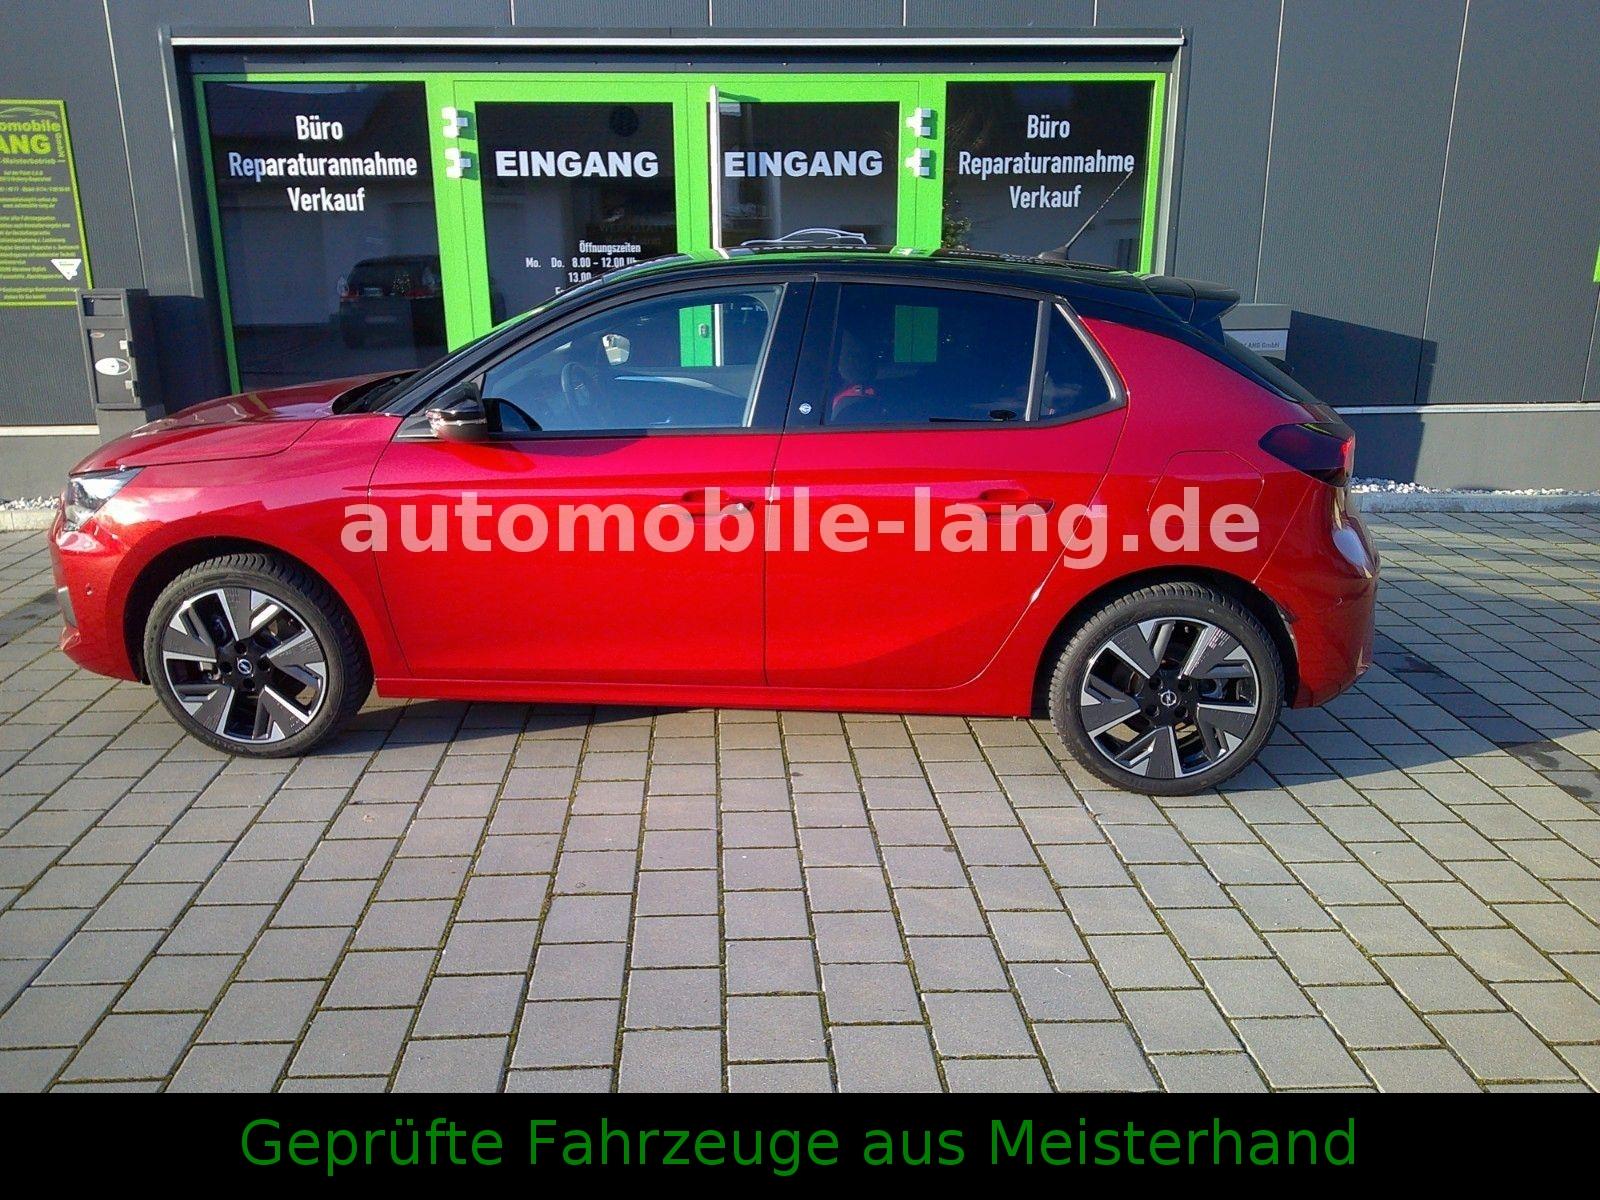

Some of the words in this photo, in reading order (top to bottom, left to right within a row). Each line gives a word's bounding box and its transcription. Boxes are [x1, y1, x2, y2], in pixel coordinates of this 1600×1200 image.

[295, 114, 344, 140] Büro
[1027, 114, 1071, 139] Büro
[228, 151, 418, 182] Reparaturannahme
[495, 150, 659, 178] EINGANG
[724, 150, 883, 178] EINGANG
[958, 149, 1135, 181] Reparaturannahme
[287, 186, 366, 212] Verkauf
[1010, 184, 1082, 209] Verkauf
[579, 240, 642, 256] Öffnungszeiten
[525, 257, 541, 268] Mo.
[551, 257, 565, 268] Do.
[572, 257, 591, 268] 8.00
[601, 257, 624, 268] 12.00
